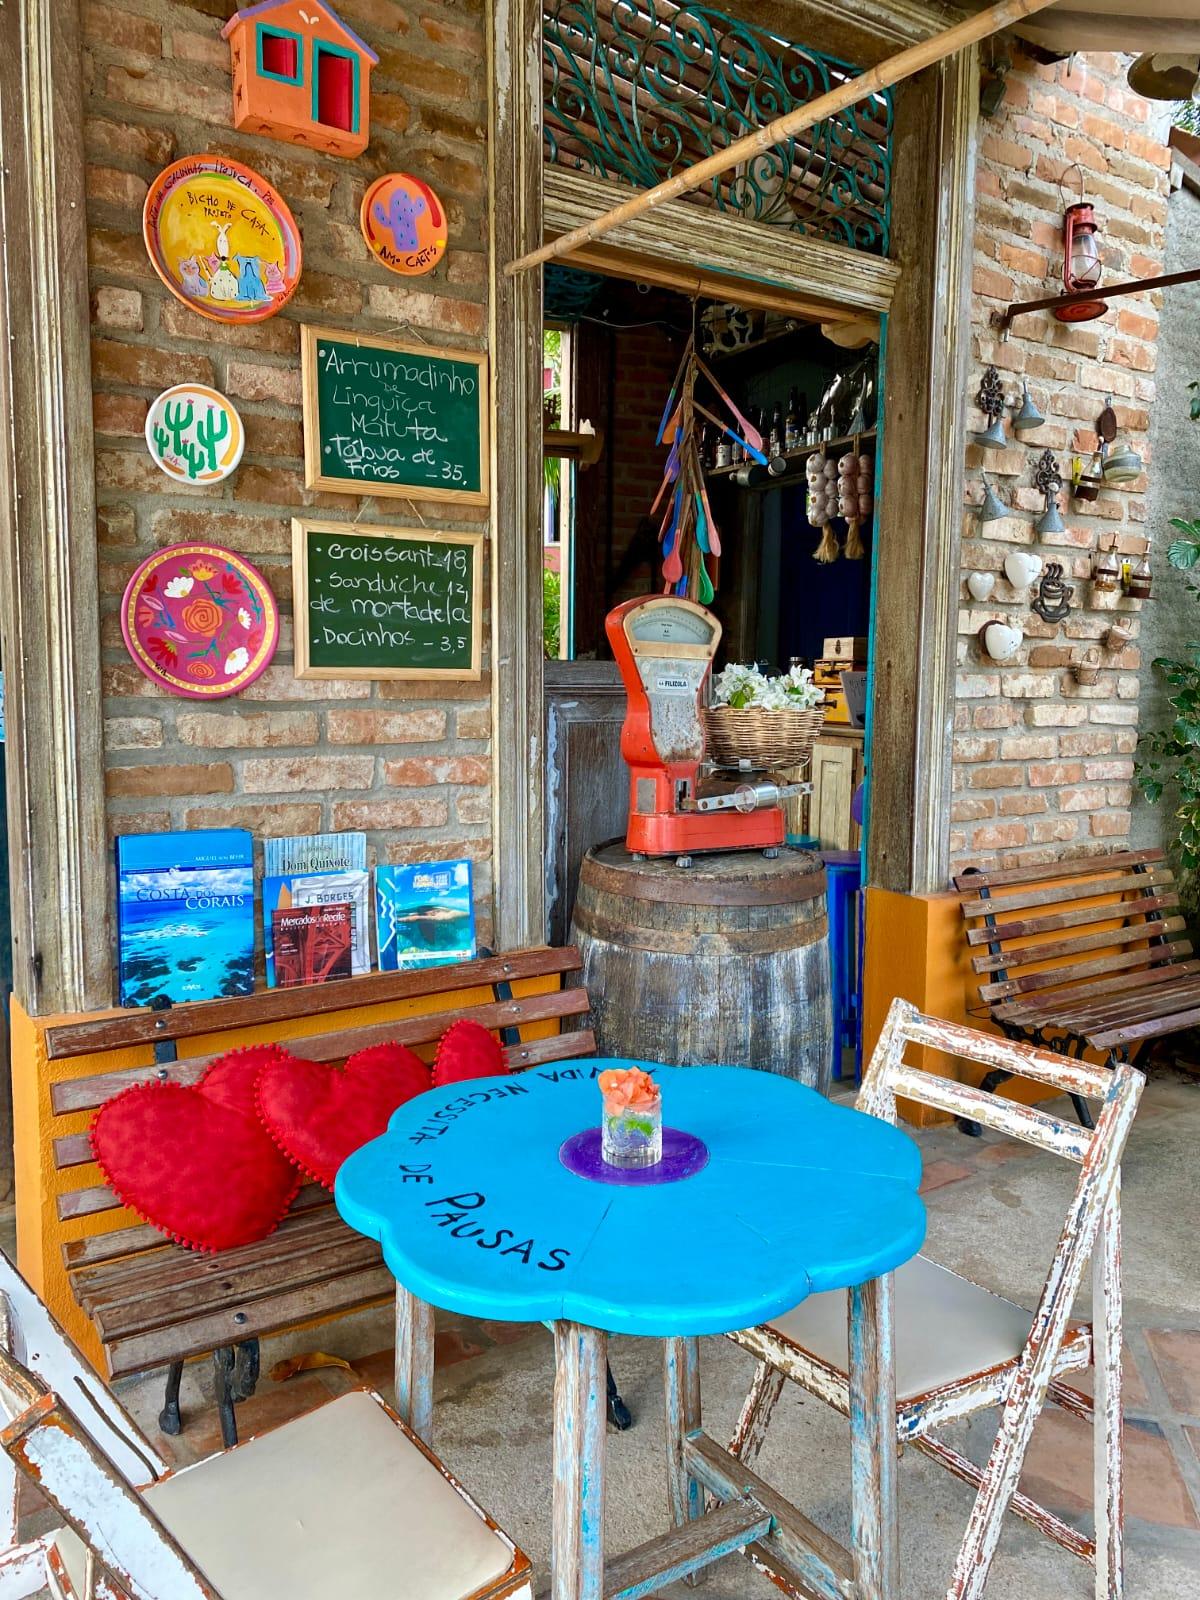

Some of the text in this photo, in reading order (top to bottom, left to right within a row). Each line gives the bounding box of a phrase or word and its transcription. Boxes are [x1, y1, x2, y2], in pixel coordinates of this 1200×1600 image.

[187, 191, 270, 236] BICHO DE CASA
[203, 206, 232, 219] PROJETO
[325, 347, 475, 396] Arrumadinho
[333, 384, 437, 421] Linguiça
[329, 434, 436, 465] Tábua de
[344, 459, 400, 479] Frios
[310, 593, 471, 625] de mortadela
[322, 622, 416, 648] Docinhos
[282, 856, 351, 872] Dom Quixote
[136, 887, 216, 901] COSTA DOS
[185, 895, 244, 911] CORAIS
[316, 891, 354, 903] BORGES
[280, 914, 316, 928] Mercados
[408, 1081, 529, 1145] NECESSITA
[399, 1164, 434, 1185] DE
[425, 1191, 571, 1271] PAUSAS
